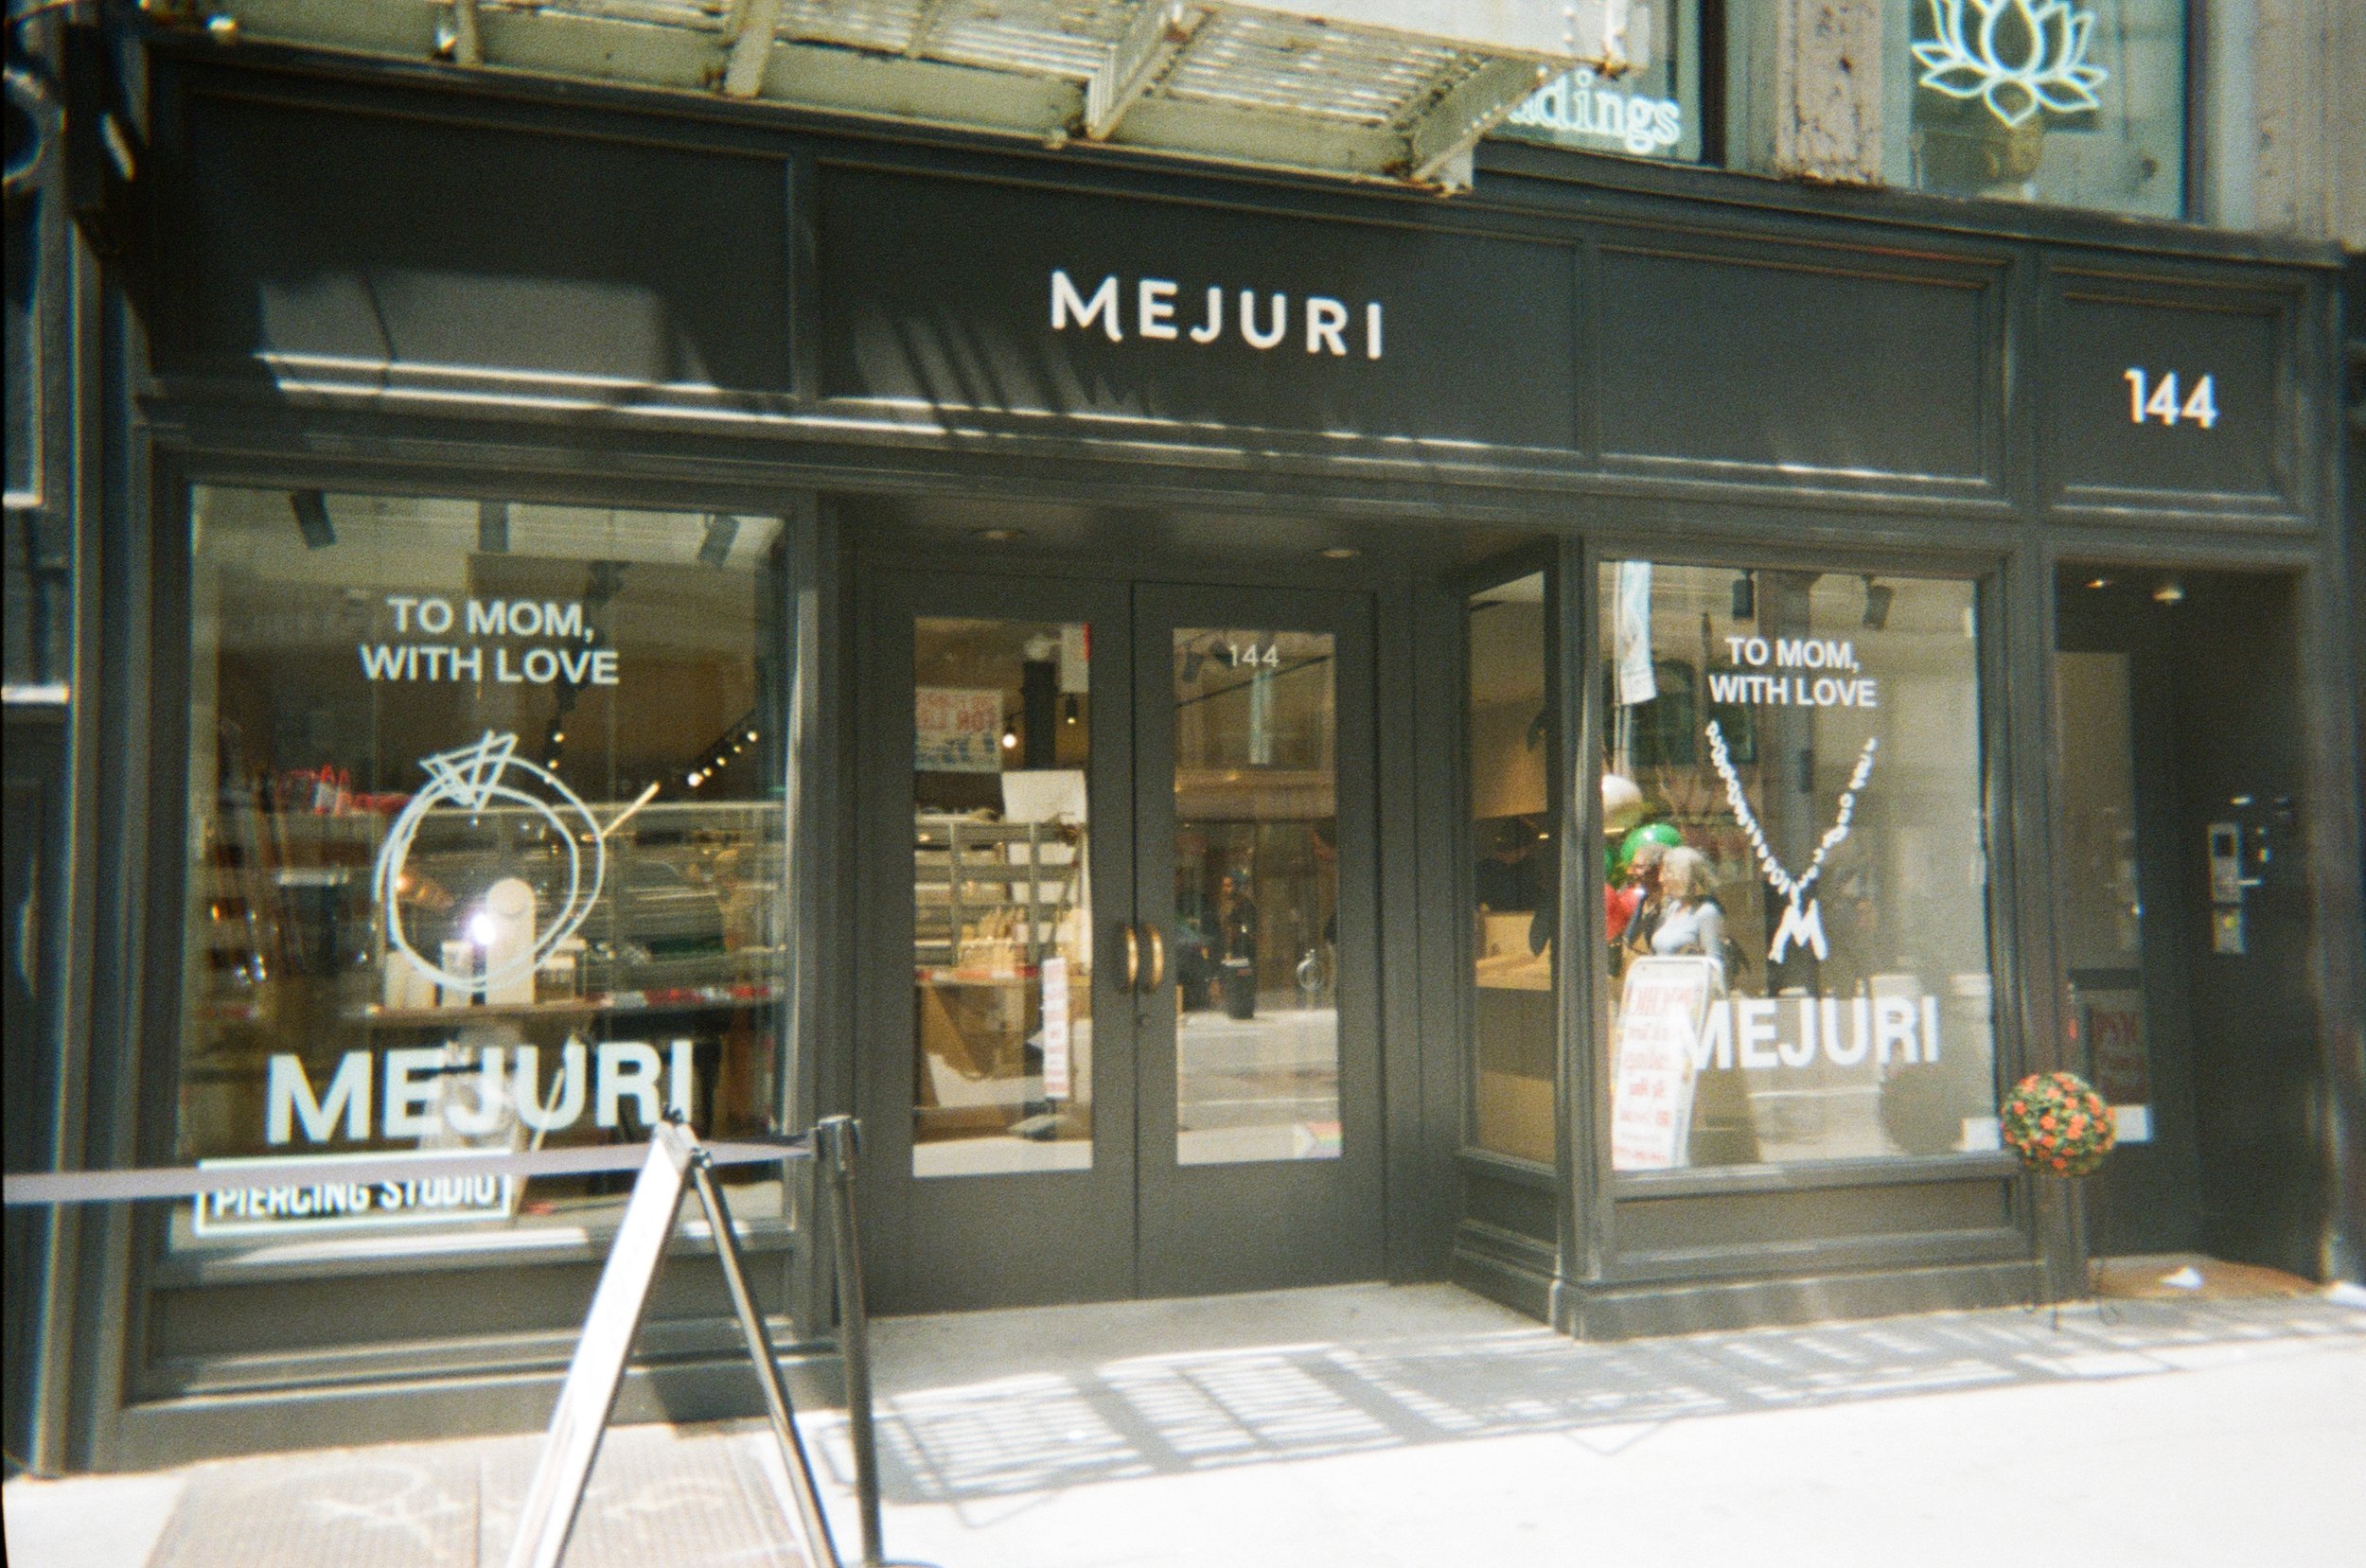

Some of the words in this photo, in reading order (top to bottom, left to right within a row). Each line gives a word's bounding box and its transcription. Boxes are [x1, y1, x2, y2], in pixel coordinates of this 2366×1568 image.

[1051, 271, 1382, 360] MEJURI
[2124, 366, 2219, 430] 144
[386, 596, 453, 634] TO
[466, 599, 594, 643] MOM,
[359, 643, 483, 681] WITH
[495, 647, 620, 684] LOVE
[1229, 644, 1280, 668] 144
[1725, 637, 1769, 666] TO
[1775, 639, 1862, 674] MOM,
[1708, 675, 1789, 705] WITH
[1795, 678, 1879, 708] LOVE
[1671, 995, 1939, 1070] MEJURI
[266, 1039, 695, 1145] MEJURI
[213, 1182, 371, 1218] PIERCING
[380, 1174, 497, 1210] STUDIO
